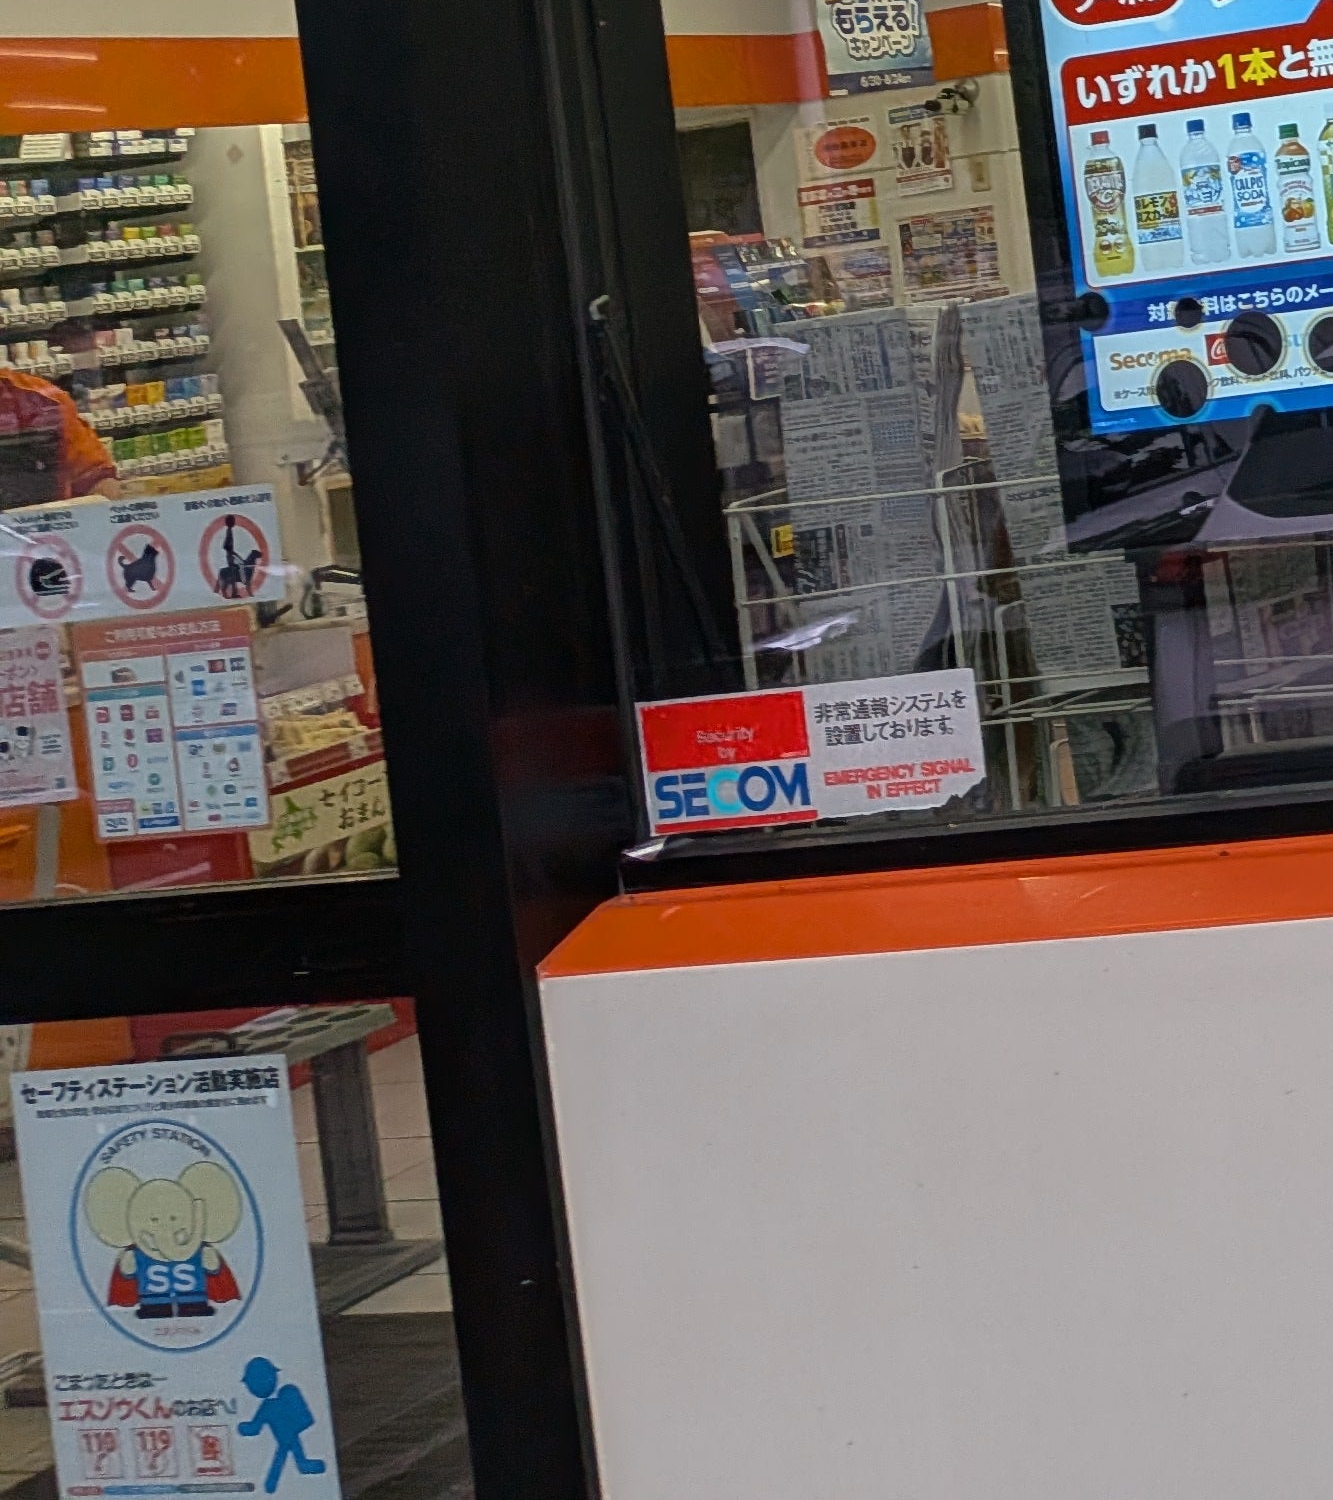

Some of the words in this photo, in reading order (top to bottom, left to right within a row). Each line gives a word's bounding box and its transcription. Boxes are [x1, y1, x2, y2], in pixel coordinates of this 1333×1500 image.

[849, 35, 913, 54] キャンペーン
[1110, 347, 1193, 371] Secoma
[813, 690, 968, 725] 非常通報システムを
[825, 715, 956, 747] 設置しております。
[823, 764, 915, 787] EMERGENCY
[921, 757, 976, 776] SIGNAL
[654, 762, 811, 819] SECOM
[867, 784, 884, 800] IN
[886, 778, 943, 799] EFFECT
[100, 1129, 148, 1164] SAFETY
[153, 1127, 212, 1158] STATION
[147, 1264, 198, 1294] SS
